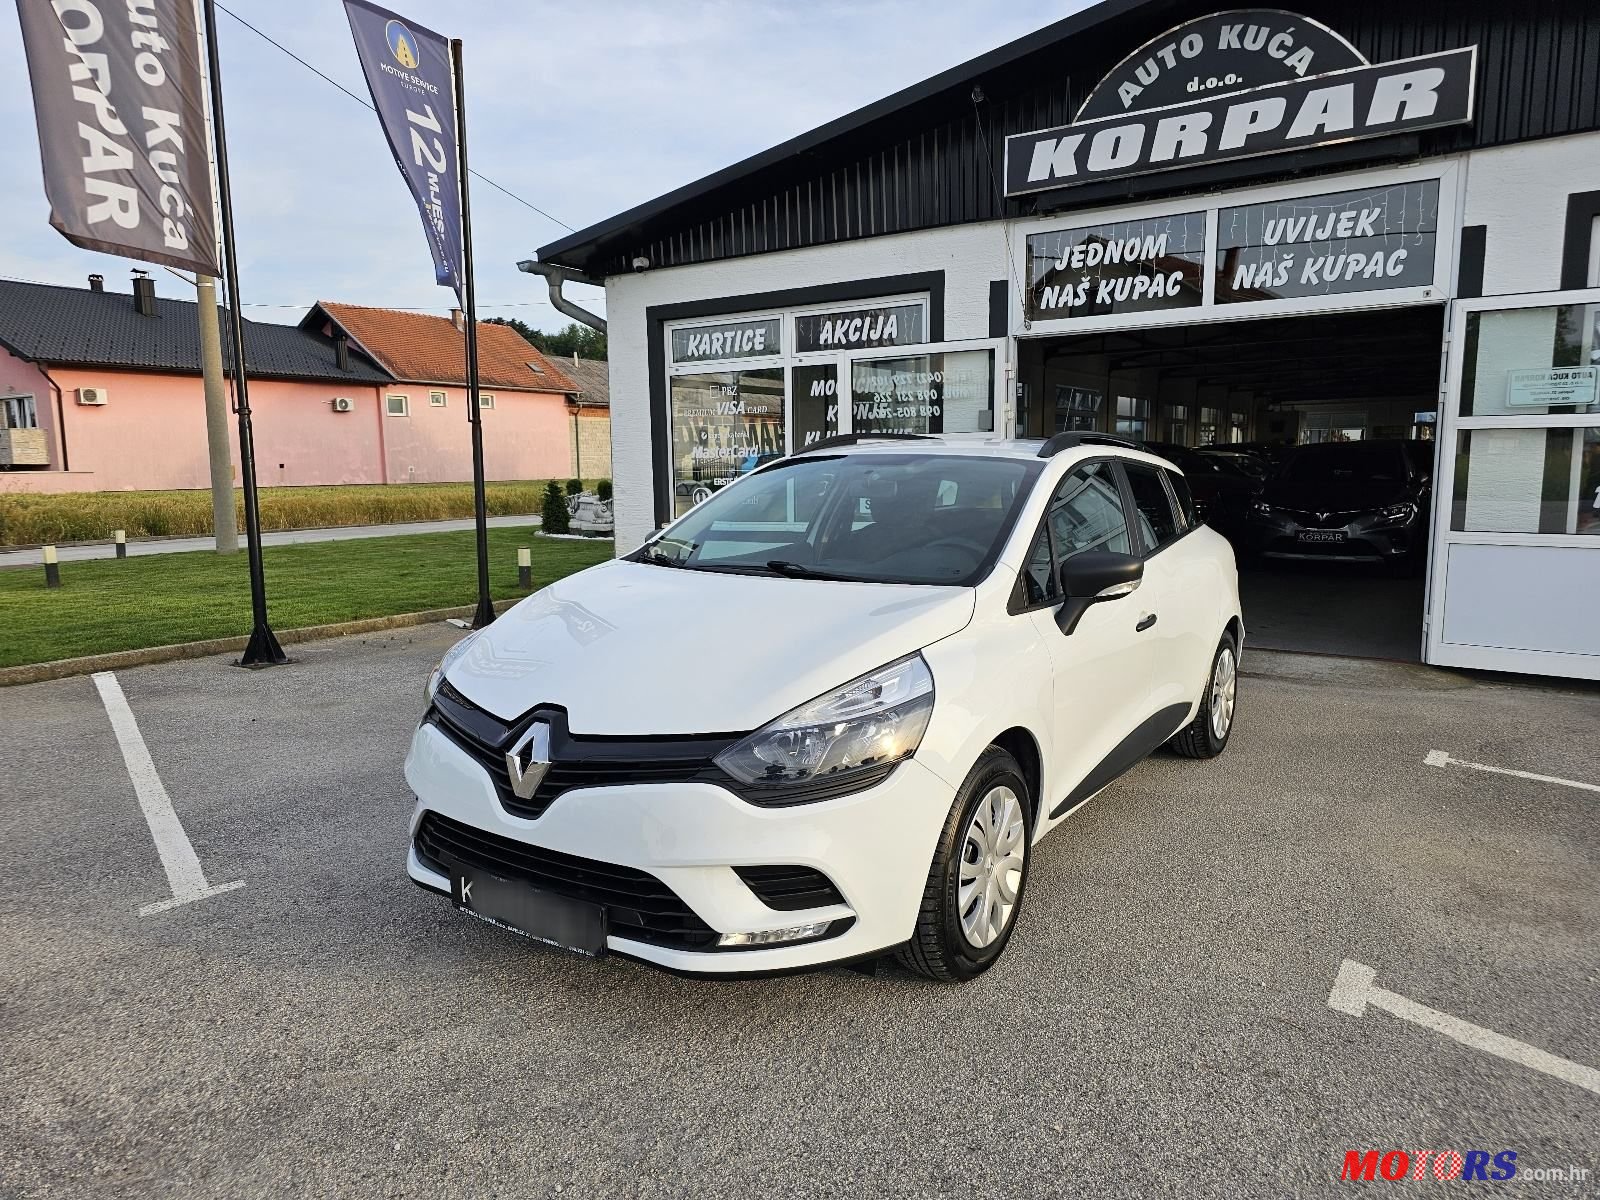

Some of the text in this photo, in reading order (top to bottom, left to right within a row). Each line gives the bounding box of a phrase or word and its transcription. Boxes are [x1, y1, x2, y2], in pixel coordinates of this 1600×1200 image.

[380, 62, 439, 95] MOTIVE SERVICE
[1116, 23, 1316, 109] AUTO KUĆA
[1186, 72, 1244, 93] d.o.o.
[51, 0, 141, 230] ORPAR
[127, 0, 195, 251] uto Kuća
[1026, 66, 1446, 183] KORPAR
[405, 103, 447, 174] 12
[427, 171, 446, 240] MJES
[1263, 207, 1383, 247] UVIJEK
[1053, 233, 1169, 272] JEDNOM
[1232, 249, 1408, 291] NAŠ KUPAC
[1039, 271, 1184, 311] NAŠ KUPAC
[686, 328, 766, 357] KARTICE
[819, 314, 898, 345] AKCIJA
[716, 400, 746, 415] VISA
[747, 405, 769, 414] CARD
[721, 386, 738, 396] PBZ
[691, 444, 758, 458] MasterCard
[1299, 532, 1343, 541] KORPAR
